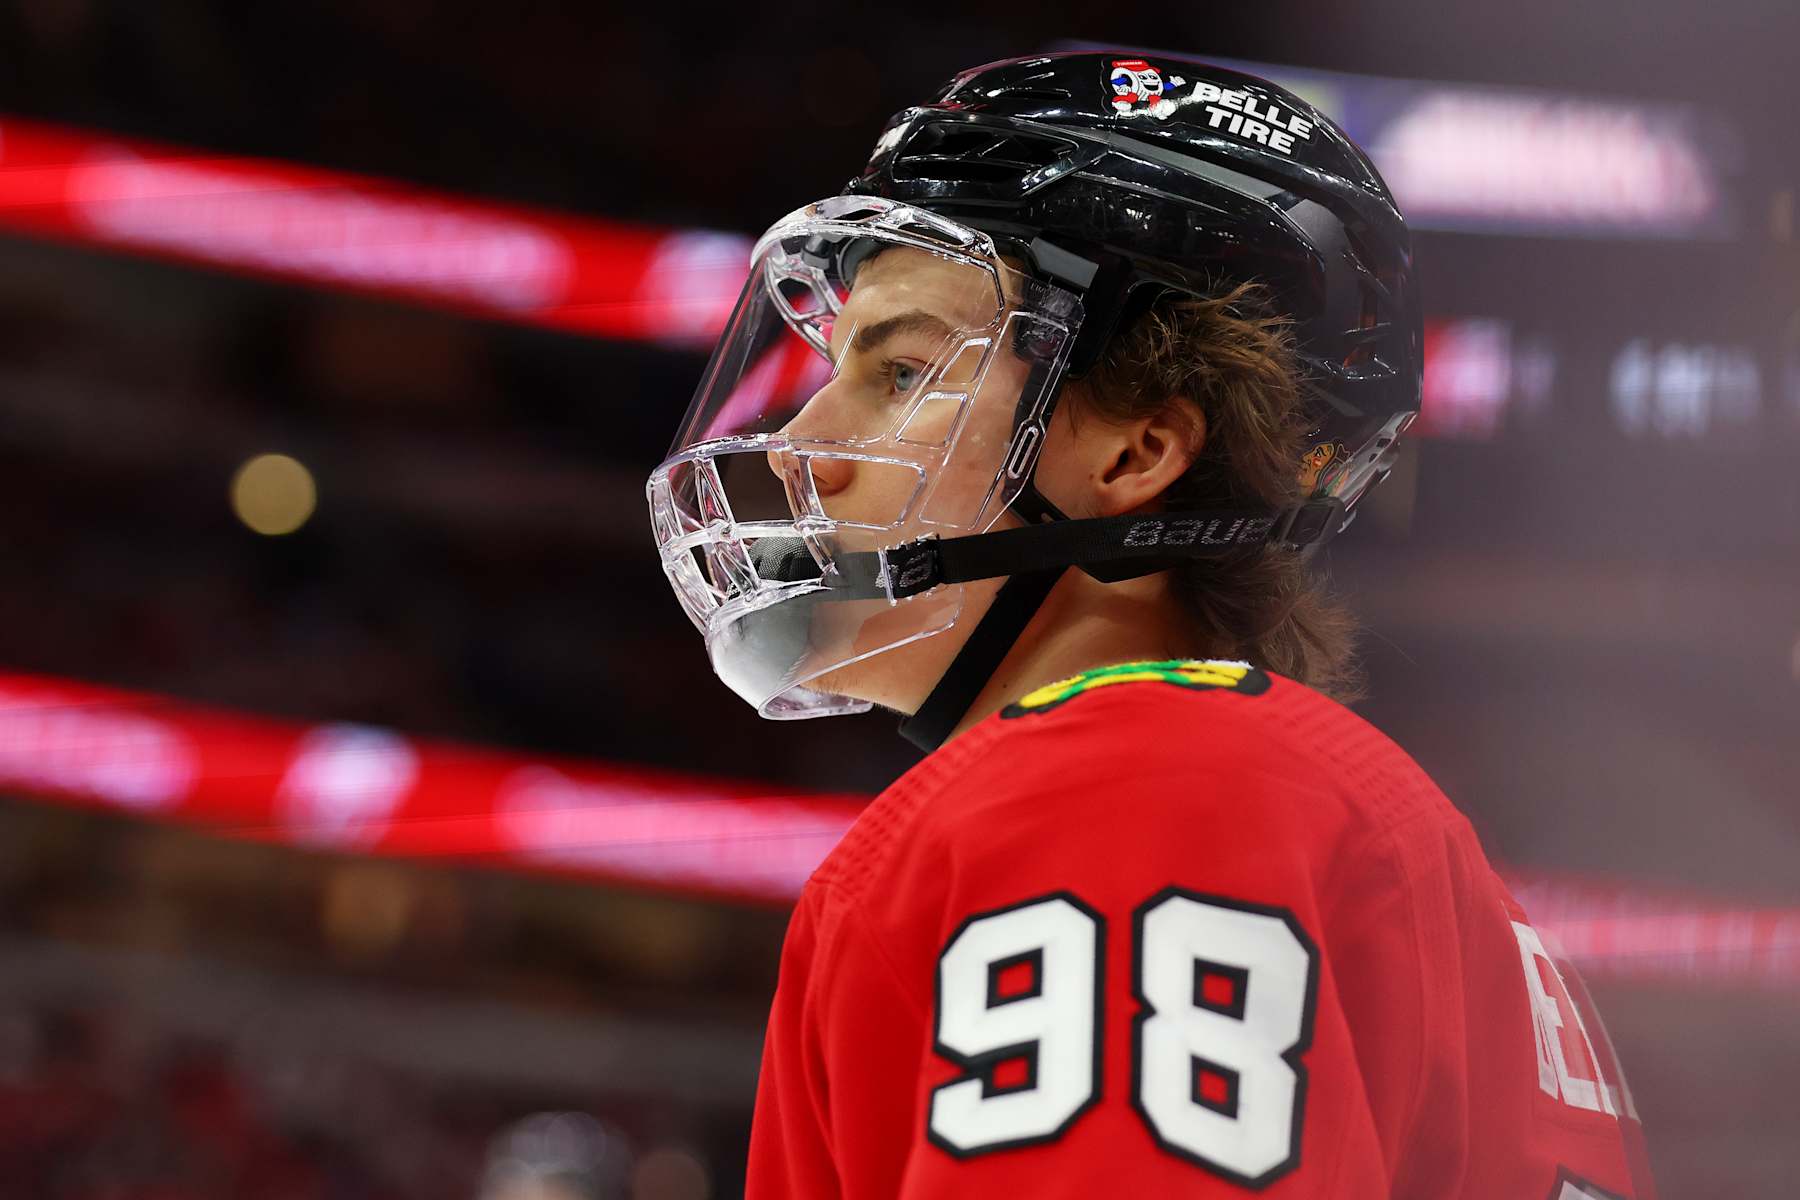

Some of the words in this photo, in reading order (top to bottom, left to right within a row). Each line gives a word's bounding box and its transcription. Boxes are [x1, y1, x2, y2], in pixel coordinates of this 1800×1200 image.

[1192, 81, 1315, 140] BELLE
[1205, 105, 1296, 155] TIRE
[928, 886, 1320, 1192] 98
